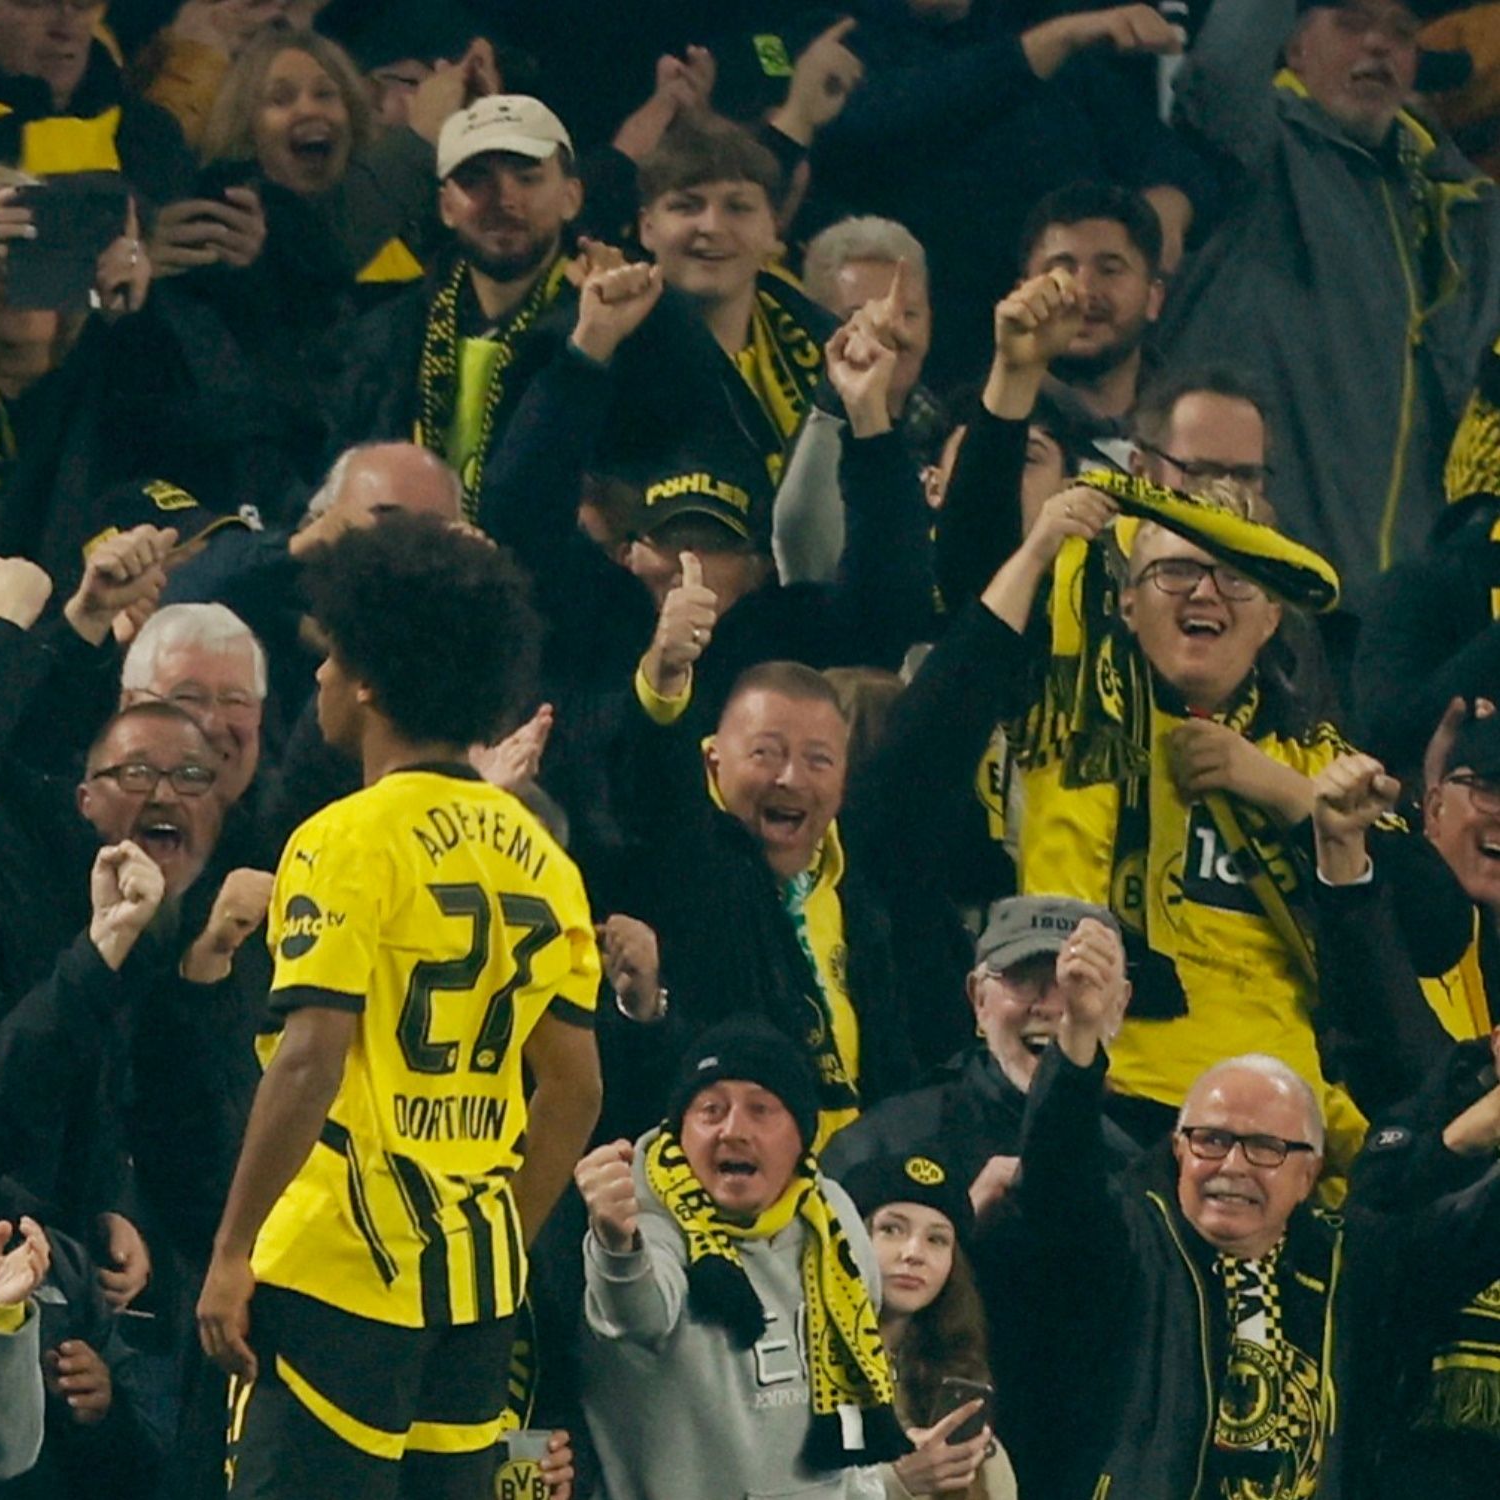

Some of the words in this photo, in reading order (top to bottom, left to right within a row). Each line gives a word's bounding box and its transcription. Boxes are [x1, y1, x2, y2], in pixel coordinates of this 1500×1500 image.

[411, 801, 547, 881] ADEYEMI
[396, 881, 562, 1075] 27
[393, 1093, 508, 1141] DORTMUN
[501, 1464, 546, 1500] BVB
